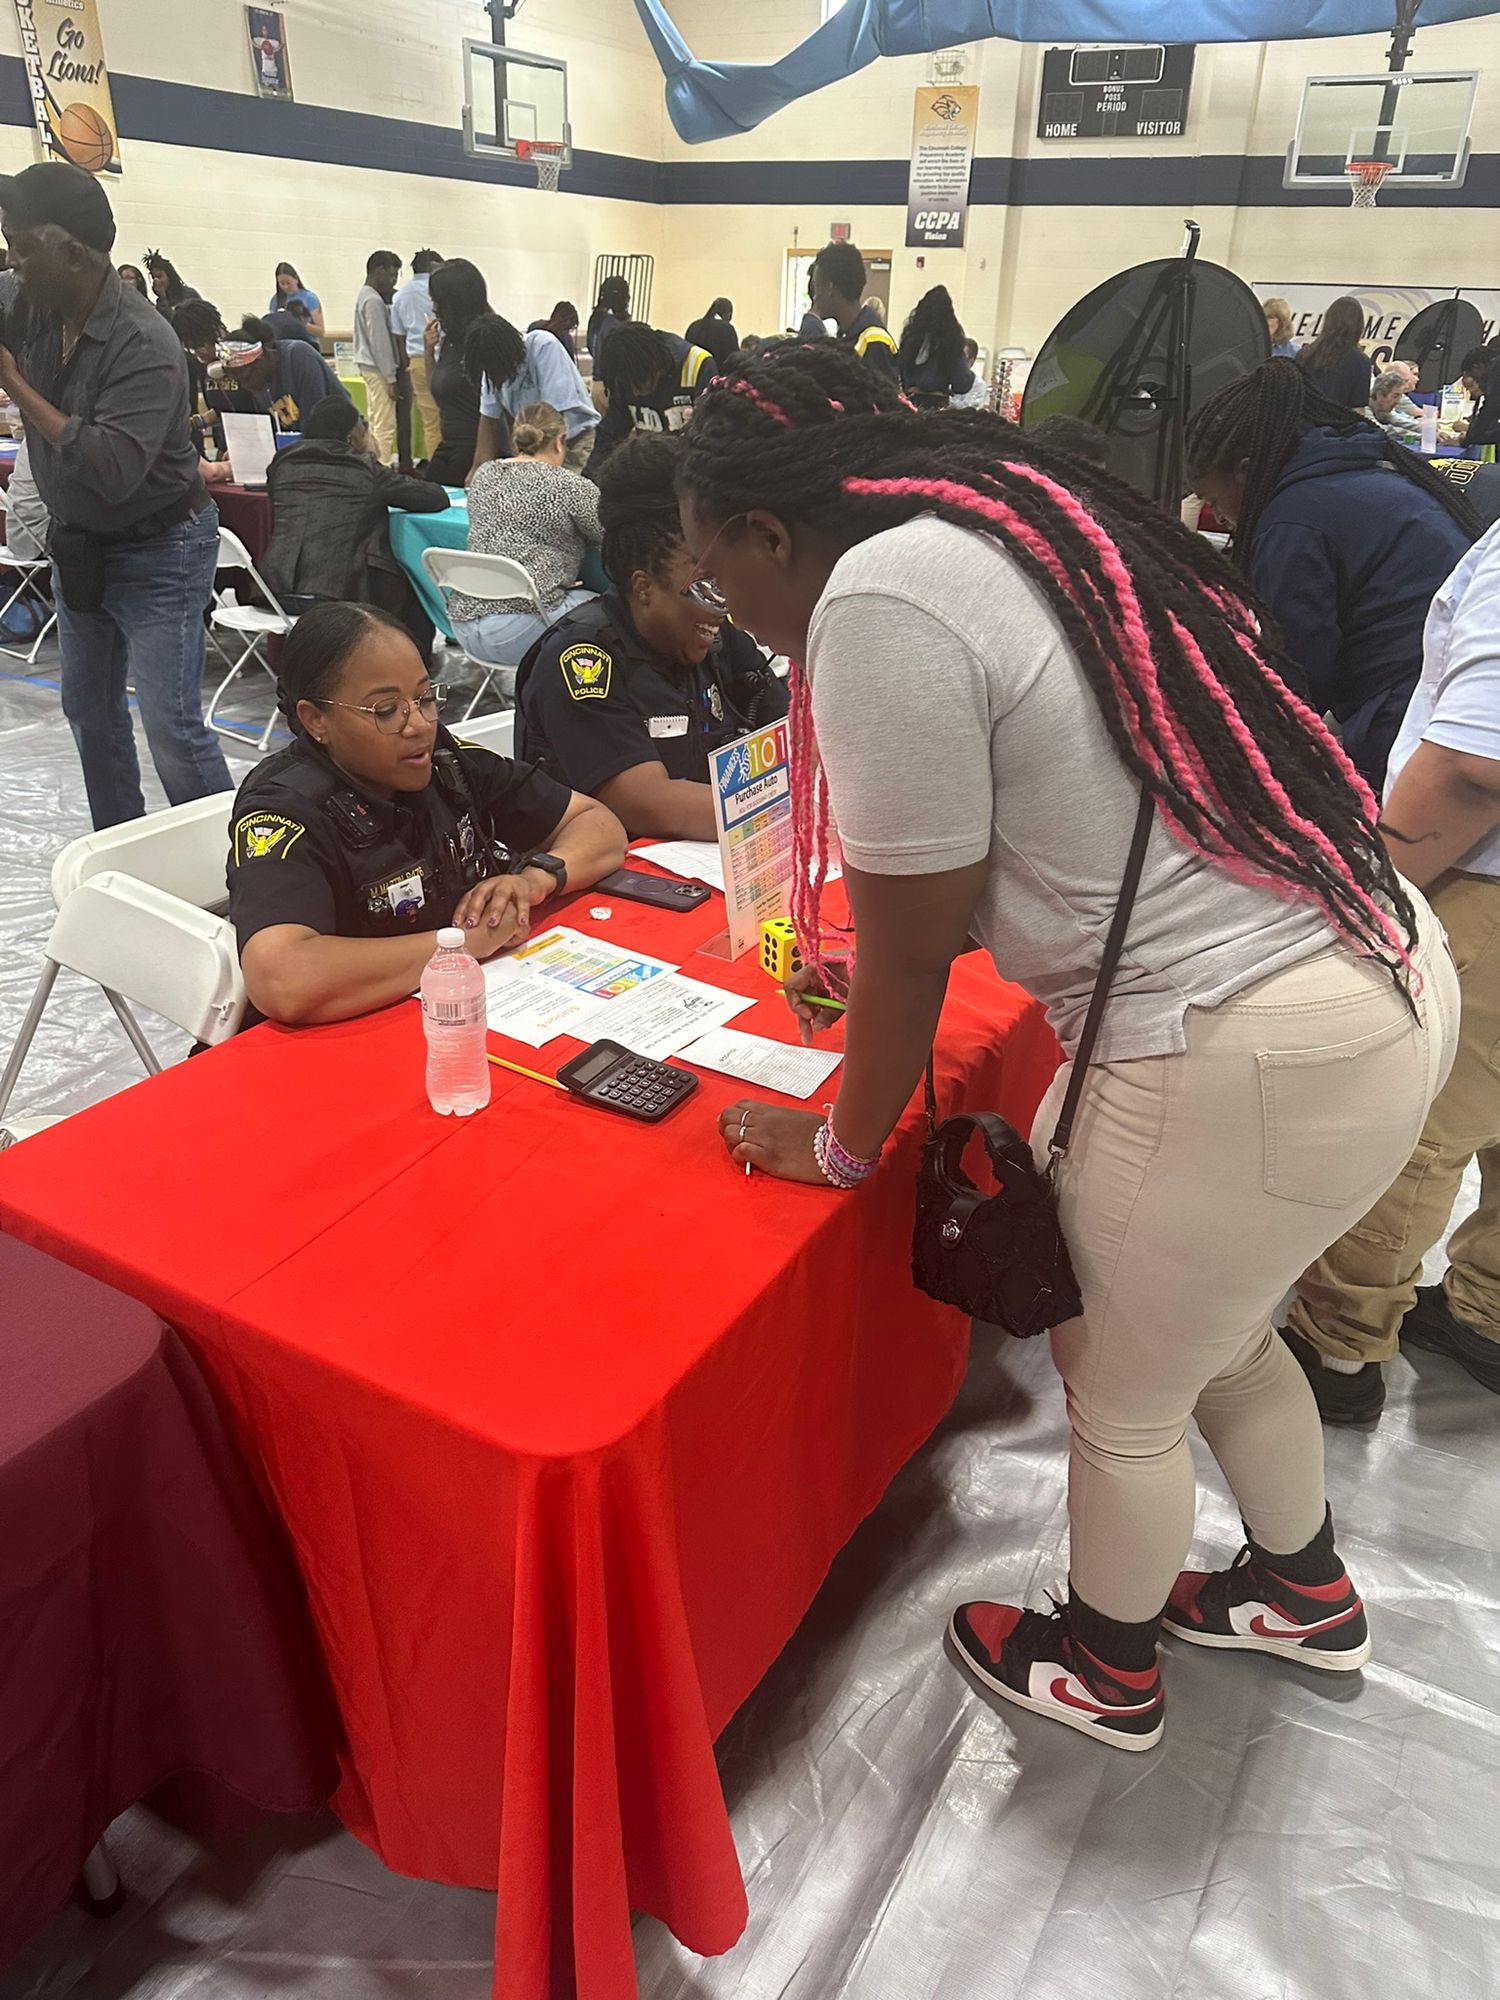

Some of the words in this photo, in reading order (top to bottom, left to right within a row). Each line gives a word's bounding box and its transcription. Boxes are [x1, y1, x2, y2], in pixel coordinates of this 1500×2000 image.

[57, 17, 85, 50] Go
[46, 50, 105, 86] Lions!
[1103, 85, 1125, 93] BONUS
[1104, 93, 1121, 101] POSS
[1096, 102, 1127, 112] PERIOD
[1045, 123, 1078, 137] HOME
[1136, 121, 1181, 135] VISITOR
[914, 211, 961, 230] CCPA
[924, 231, 947, 240] Vision
[563, 647, 609, 663] CINCINNATI
[574, 687, 605, 696] POLICE
[751, 730, 786, 773] 101
[734, 783, 763, 805] Purchase
[763, 775, 778, 791] Auto
[240, 814, 301, 833] CINCINNATI
